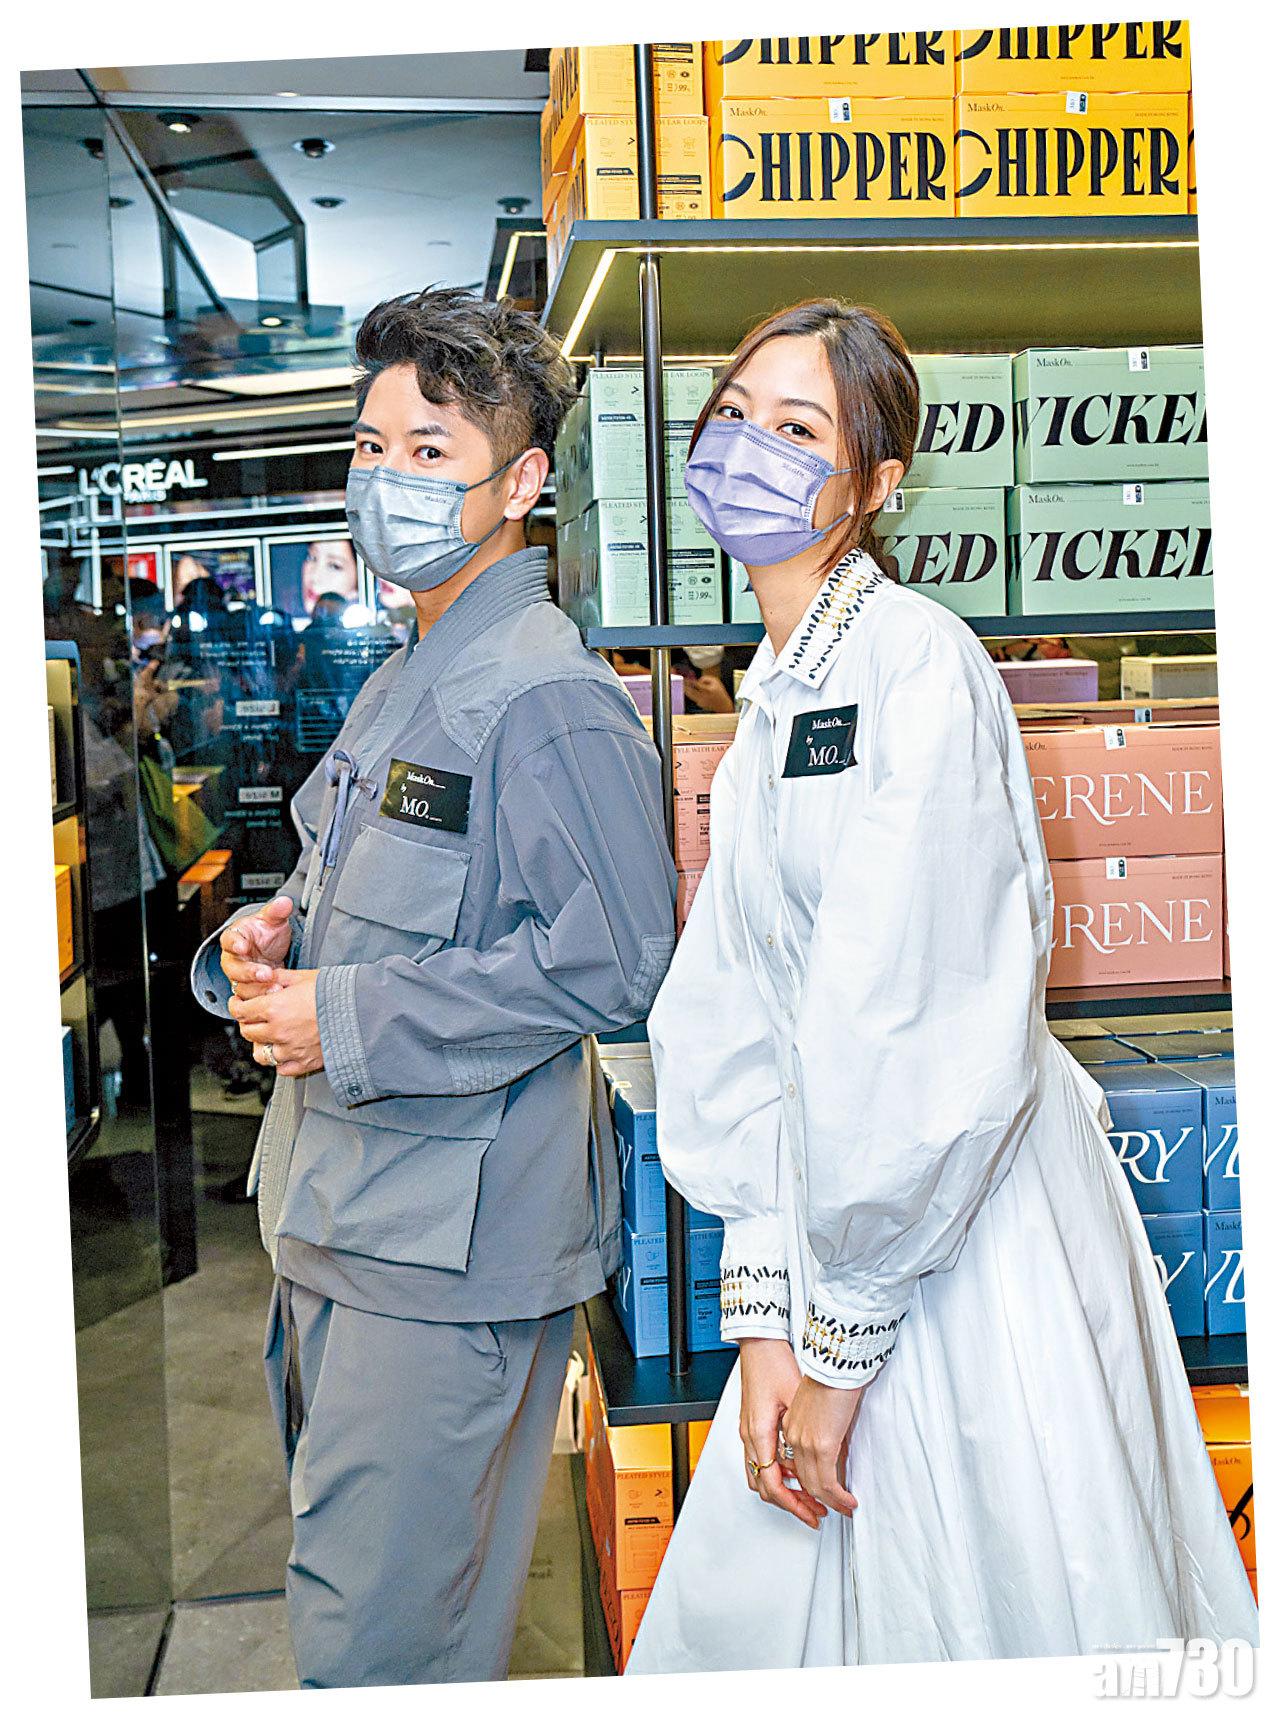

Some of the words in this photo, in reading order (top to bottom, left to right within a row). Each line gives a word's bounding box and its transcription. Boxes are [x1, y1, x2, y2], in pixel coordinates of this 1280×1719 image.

[715, 131, 946, 202] CHIPPER
[954, 127, 1179, 198] CHIPPER
[1013, 390, 1208, 449] WICKE
[1050, 899, 1214, 954] RENE
